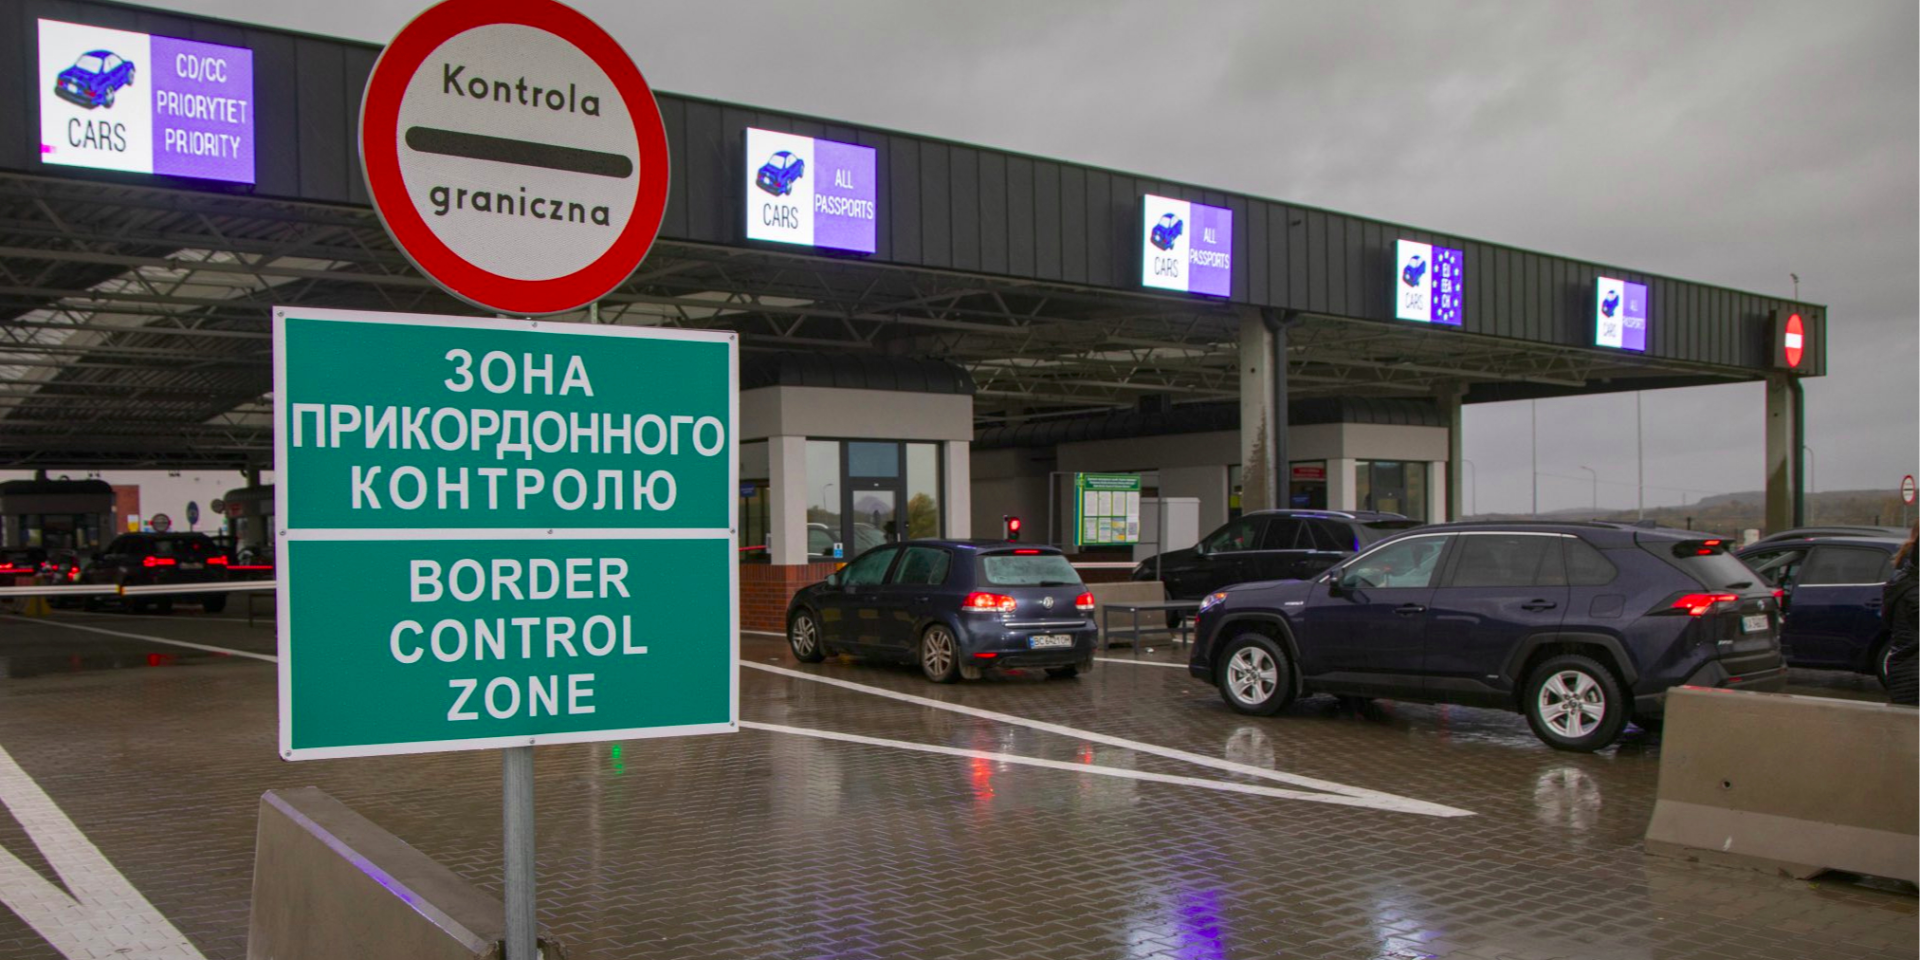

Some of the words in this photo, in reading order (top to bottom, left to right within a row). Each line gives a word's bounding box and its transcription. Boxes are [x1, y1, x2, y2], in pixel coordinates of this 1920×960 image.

[175, 53, 227, 83] CD/CC
[156, 89, 248, 124] PRIORYTET
[443, 63, 600, 117] Kontrola
[67, 117, 127, 153] CARS
[164, 127, 241, 159] PRIORITY
[834, 168, 854, 190] ALL
[429, 186, 610, 227] graniczna
[762, 203, 799, 230] CARS
[814, 193, 874, 220] PASSPORTS
[1203, 227, 1217, 245] ALL
[1154, 256, 1179, 278] CARS
[1189, 248, 1230, 270] PASSPORTS
[444, 348, 594, 397] ЗОНА
[292, 403, 725, 460] ПРИКОРДОННОГО
[351, 466, 677, 511] КОНТРОЛЮ
[410, 557, 631, 602] BORDER
[390, 615, 648, 664] CONTROL
[447, 673, 596, 722] ZONE
